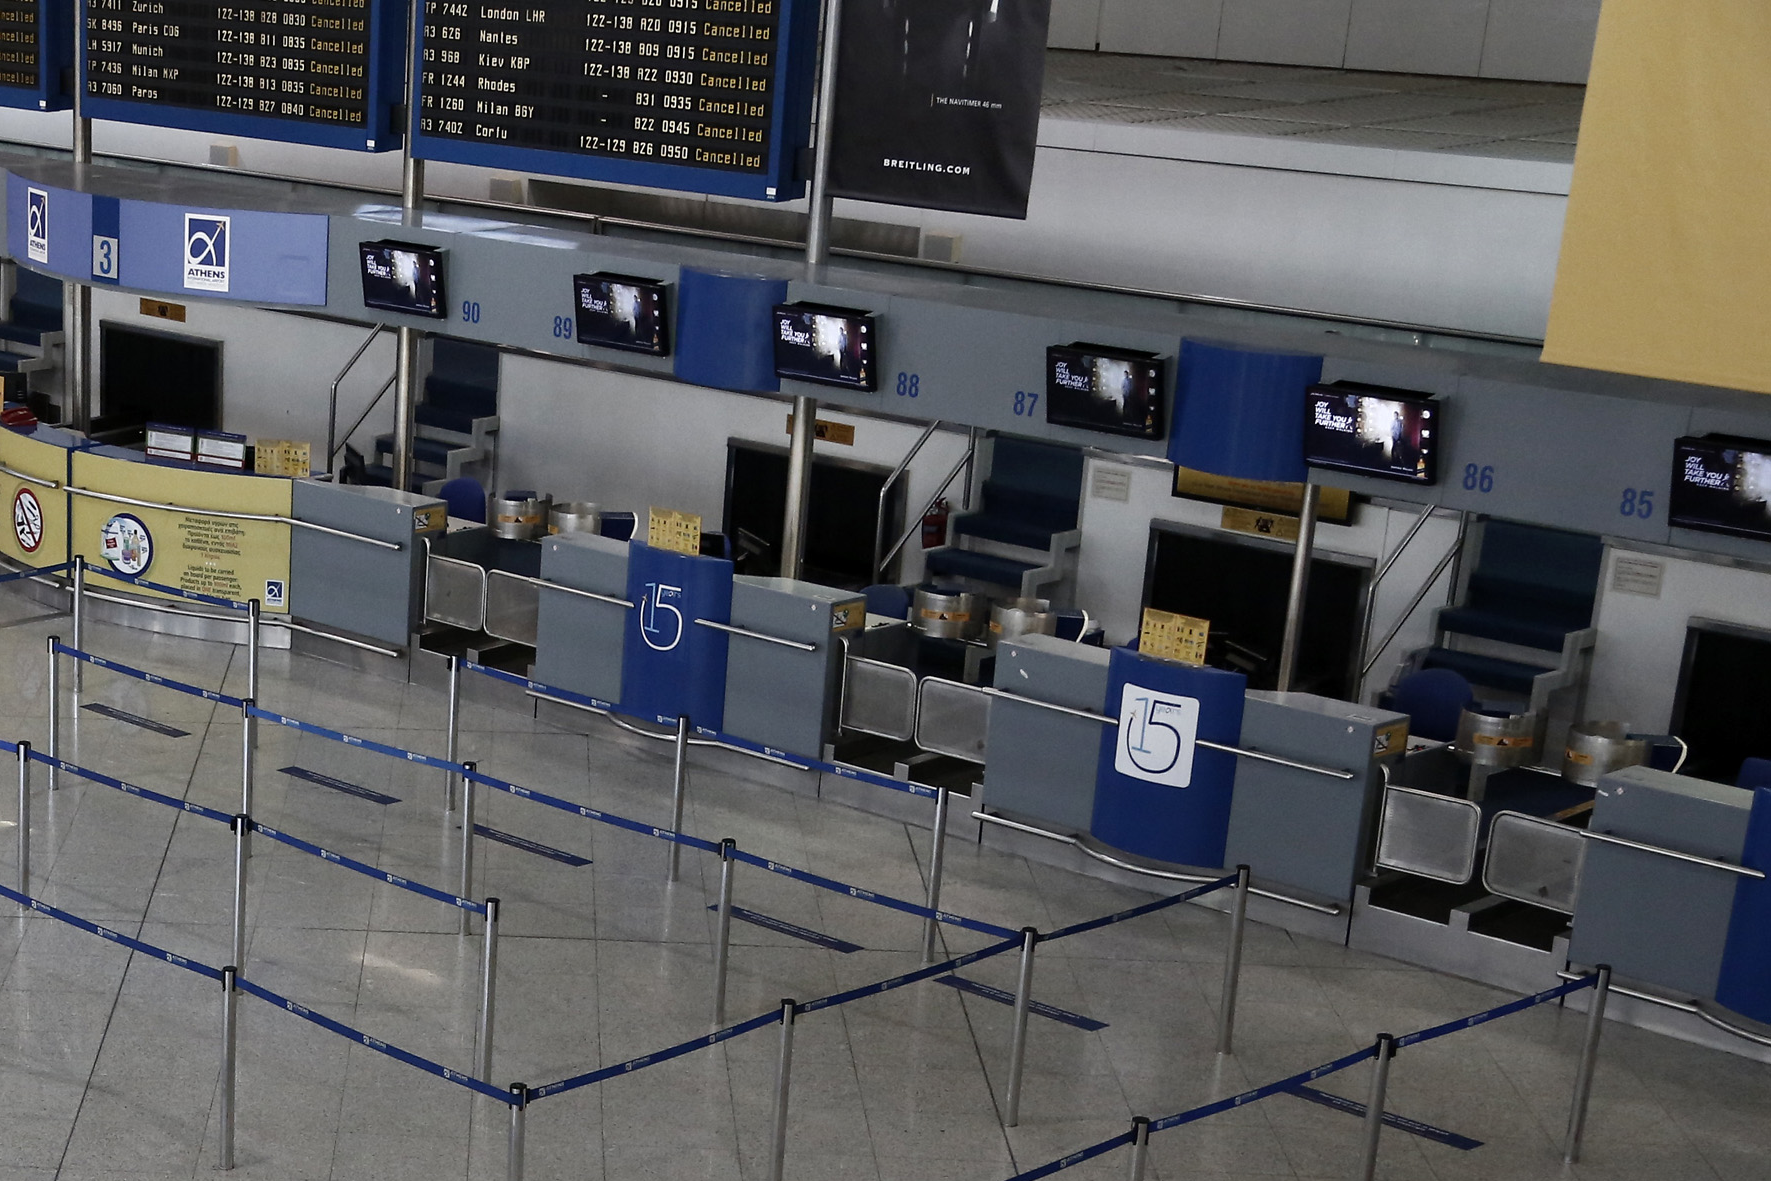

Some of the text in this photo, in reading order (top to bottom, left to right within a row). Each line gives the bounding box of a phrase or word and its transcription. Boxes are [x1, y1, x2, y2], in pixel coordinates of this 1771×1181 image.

[132, 0, 164, 14] Zurich
[217, 7, 255, 22] 122-138
[283, 13, 305, 27] 0830
[311, 15, 364, 31] Cancelled
[425, 1, 770, 40] TP 7442 London LHR 122-138 A20 0915 Cancelled
[705, 0, 772, 14] Cancelled
[101, 19, 122, 32] 8496
[132, 21, 158, 35] Paris
[217, 29, 255, 44] 122-138
[282, 35, 305, 49] 0835
[311, 38, 363, 54] Cancelled
[424, 25, 436, 38] A3
[442, 26, 461, 40] 626
[479, 29, 518, 45] Nantes
[585, 38, 632, 55] 122-138
[666, 45, 695, 60] 0915
[702, 48, 768, 66] Cancelled
[101, 40, 363, 77] 5917 Munich 122-138 0835 Cancelled
[423, 49, 767, 92] A3 968 Kiev KBP 122-138 A22 0930 Cancelled
[101, 61, 362, 100] 7436 Milan MXP 122-138 0835 Cancelled
[422, 72, 434, 85] FR
[441, 73, 465, 88] 1244
[478, 77, 516, 93] Rhodes
[663, 95, 692, 110] 0935
[698, 98, 765, 117] Cancelled
[101, 82, 362, 122] 7060 Paros 122-129 0840 Cancelled
[936, 96, 948, 105] THE
[949, 97, 982, 108] NAVITIMER
[421, 95, 433, 108] FR
[440, 97, 464, 111] 1260
[477, 101, 508, 116] Milan
[661, 120, 690, 135] 0945
[697, 123, 763, 143] Cancelled
[420, 118, 432, 131] A3
[438, 120, 463, 134] 7402
[476, 124, 507, 139] Corfu
[580, 135, 626, 152] 122-129
[660, 144, 689, 160] 0950
[695, 148, 761, 168] Cancelled
[883, 158, 971, 176] BREITLING.COM
[29, 240, 46, 251] ATHENS
[99, 240, 112, 274] 3
[188, 268, 225, 279] ATHENS
[463, 300, 480, 323] 90
[553, 315, 573, 339] 89
[896, 371, 920, 398] 88
[1013, 390, 1039, 417] 87
[1333, 415, 1347, 423] YOU
[1315, 419, 1346, 428] FURTHER
[1463, 463, 1495, 493] 86
[1684, 469, 1723, 480] TAKE YOU
[1684, 475, 1721, 486] FURTHER
[1620, 488, 1654, 520] 85
[640, 583, 683, 651] 15
[1127, 697, 1181, 774] 15
